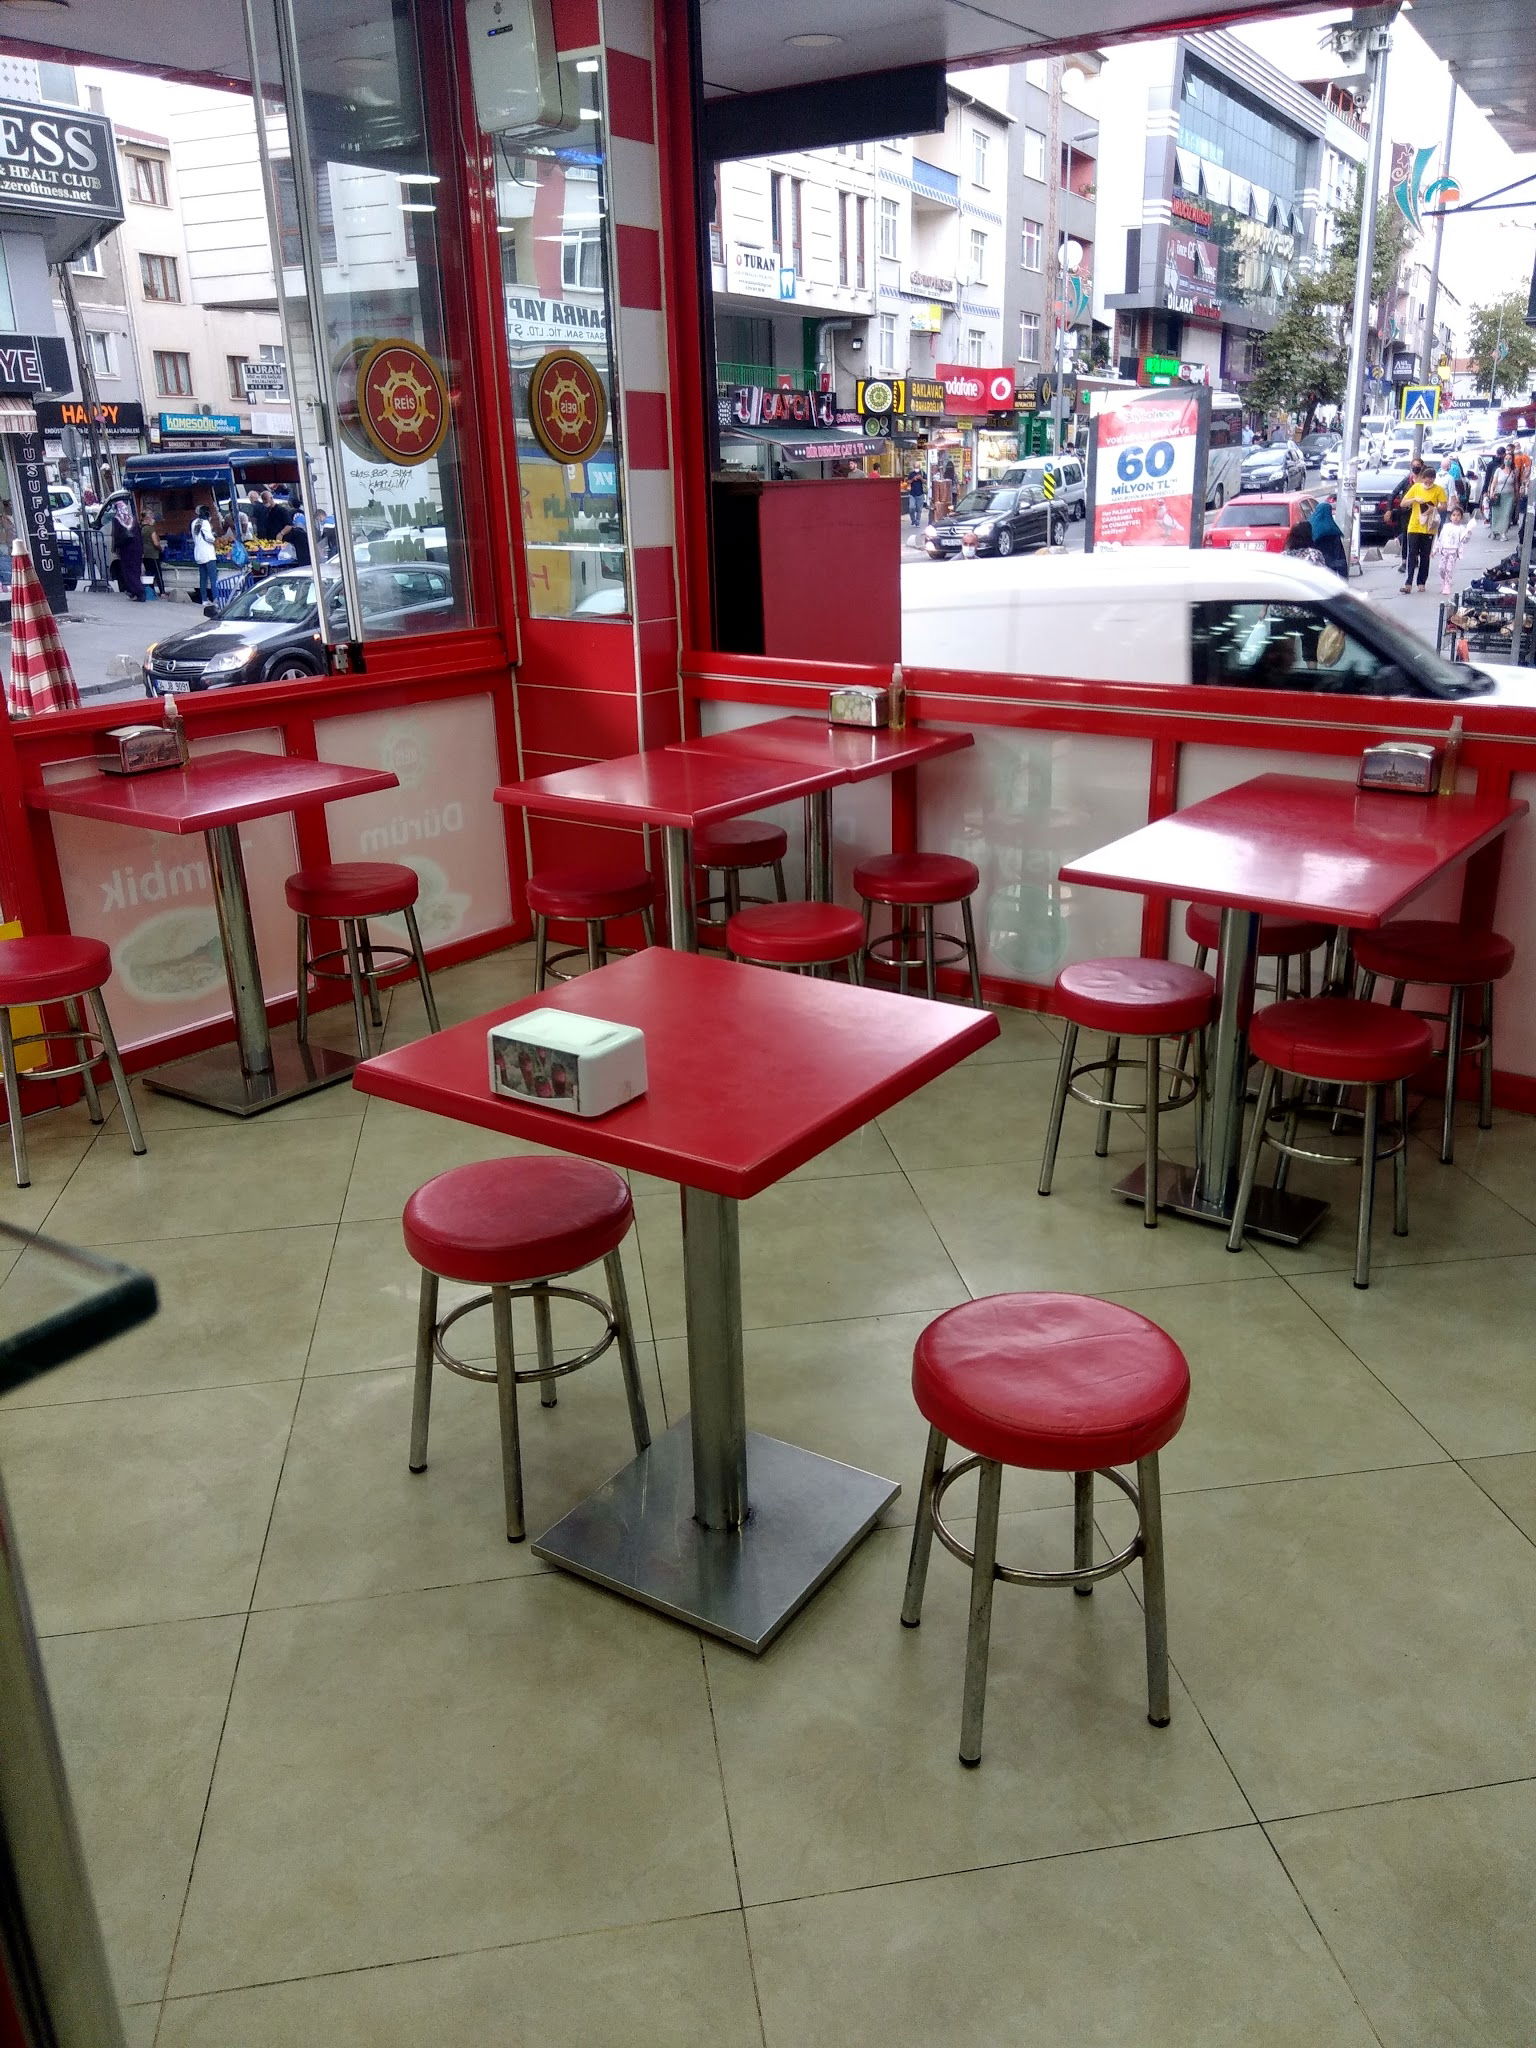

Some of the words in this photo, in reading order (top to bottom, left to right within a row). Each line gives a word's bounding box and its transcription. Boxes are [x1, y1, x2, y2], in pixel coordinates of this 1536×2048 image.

[0, 115, 97, 171] ESS
[8, 164, 59, 183] HEALT
[62, 173, 101, 189] CLUB
[744, 253, 775, 271] TURAN
[394, 395, 416, 410] REİS
[1117, 441, 1175, 482] 60
[1111, 481, 1154, 496] MİLYON
